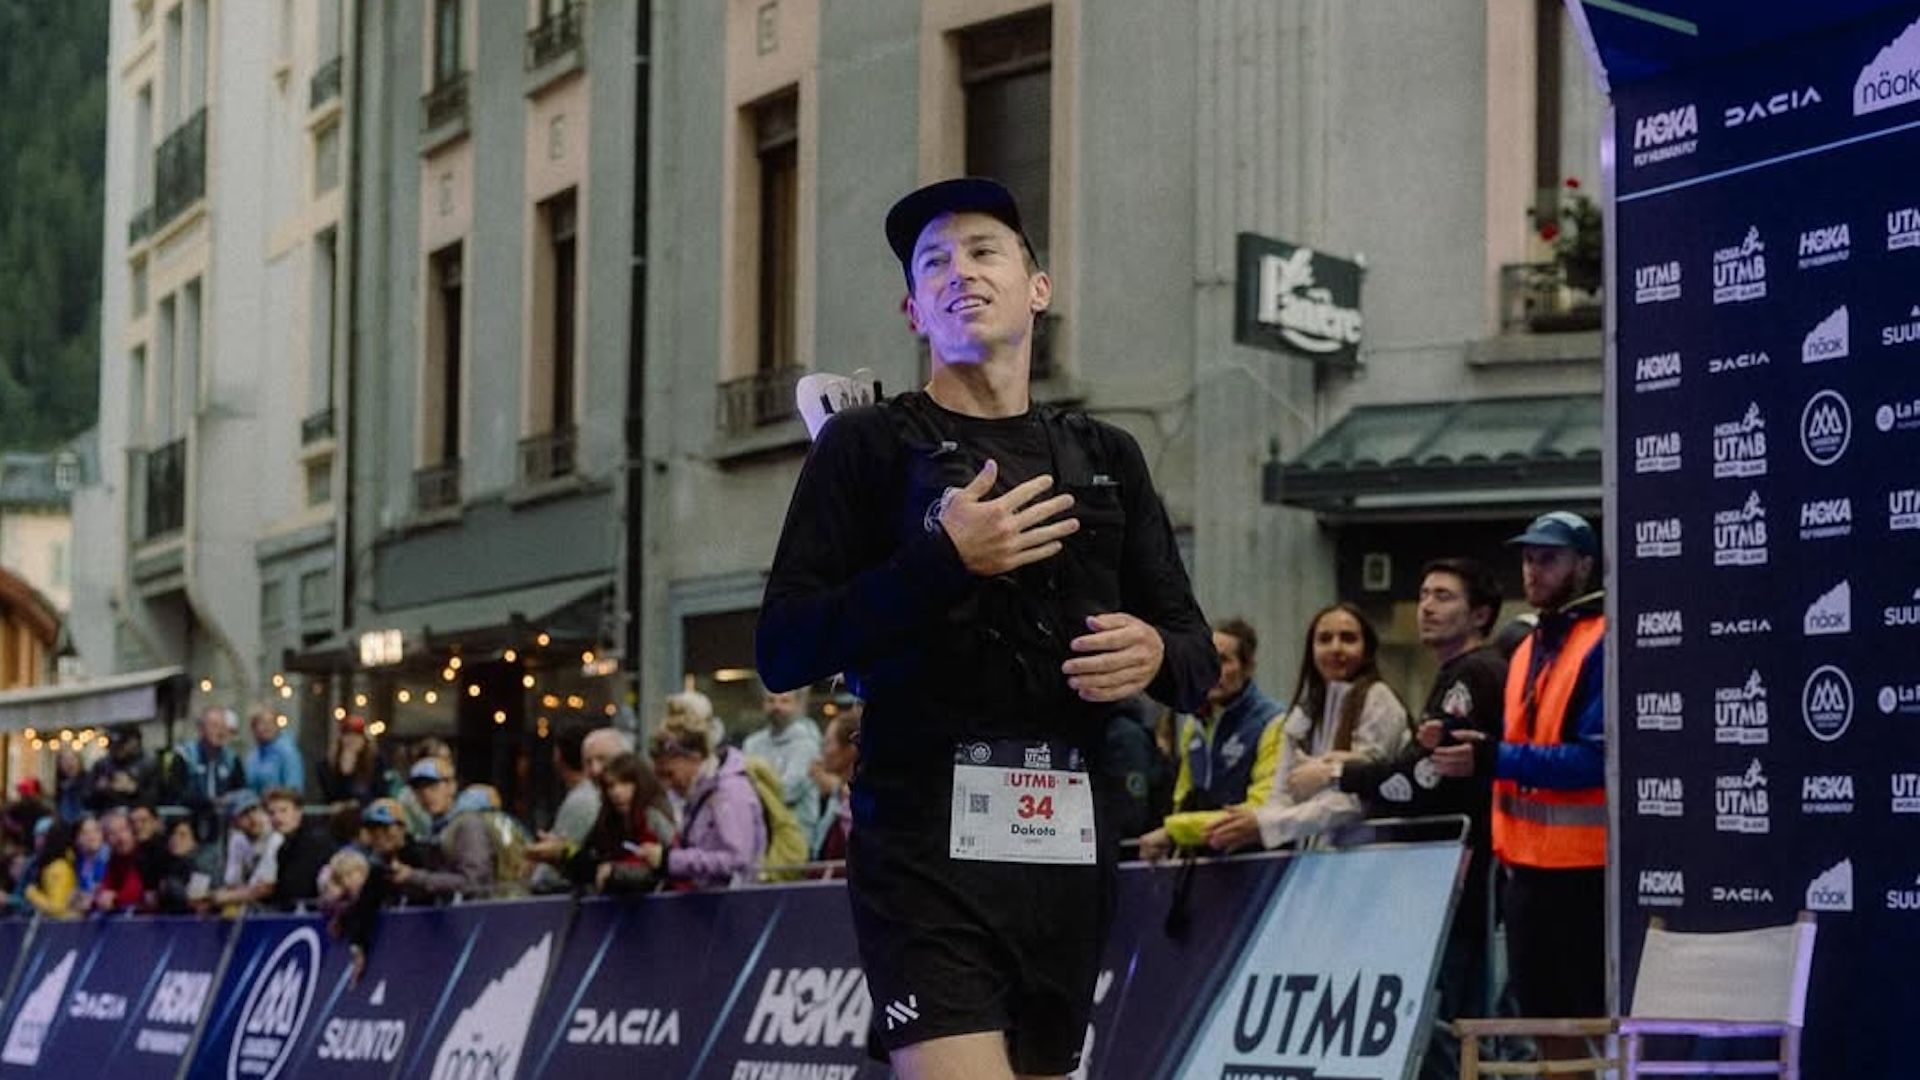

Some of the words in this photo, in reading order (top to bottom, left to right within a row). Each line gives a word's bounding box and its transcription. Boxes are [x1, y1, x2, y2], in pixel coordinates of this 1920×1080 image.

[1863, 69, 1920, 104] näak
[1724, 86, 1822, 127] DACIA
[1634, 104, 1698, 149] HOKA
[1887, 208, 1920, 234] UTM
[1799, 223, 1850, 256] HOKA
[1636, 262, 1681, 288] UTMB
[1713, 255, 1766, 287] UTMB
[1882, 322, 1920, 345] SUU
[1636, 353, 1681, 380] HOKA
[1709, 352, 1770, 373] DACIA
[1636, 433, 1681, 457] UTMB
[1713, 432, 1766, 461] UTMB
[1801, 498, 1851, 526] HOKA
[1889, 490, 1920, 513] UT
[1636, 519, 1681, 542] UTMB
[1714, 521, 1766, 548] UTMB
[1637, 610, 1682, 635] HOKA
[1710, 619, 1771, 635] DACIA
[1884, 606, 1920, 625] SUU
[1637, 692, 1682, 714] UTMB
[1715, 701, 1768, 726] UTMB
[1011, 773, 1056, 788] UTMB
[1638, 778, 1683, 799] UTMB
[1802, 776, 1853, 799] HOKA
[1891, 774, 1920, 796] UT
[1018, 794, 1053, 819] 34
[1716, 790, 1768, 815] UTMB
[1011, 824, 1055, 836] Dakota
[1639, 871, 1684, 894] HOKA
[1712, 887, 1774, 902] DACIA
[1887, 890, 1920, 909] SUU
[744, 967, 873, 1046] HOKA
[1234, 968, 1404, 1058] UTMB
[567, 1008, 680, 1045] DACIA
[318, 1017, 405, 1062] SUUNTO
